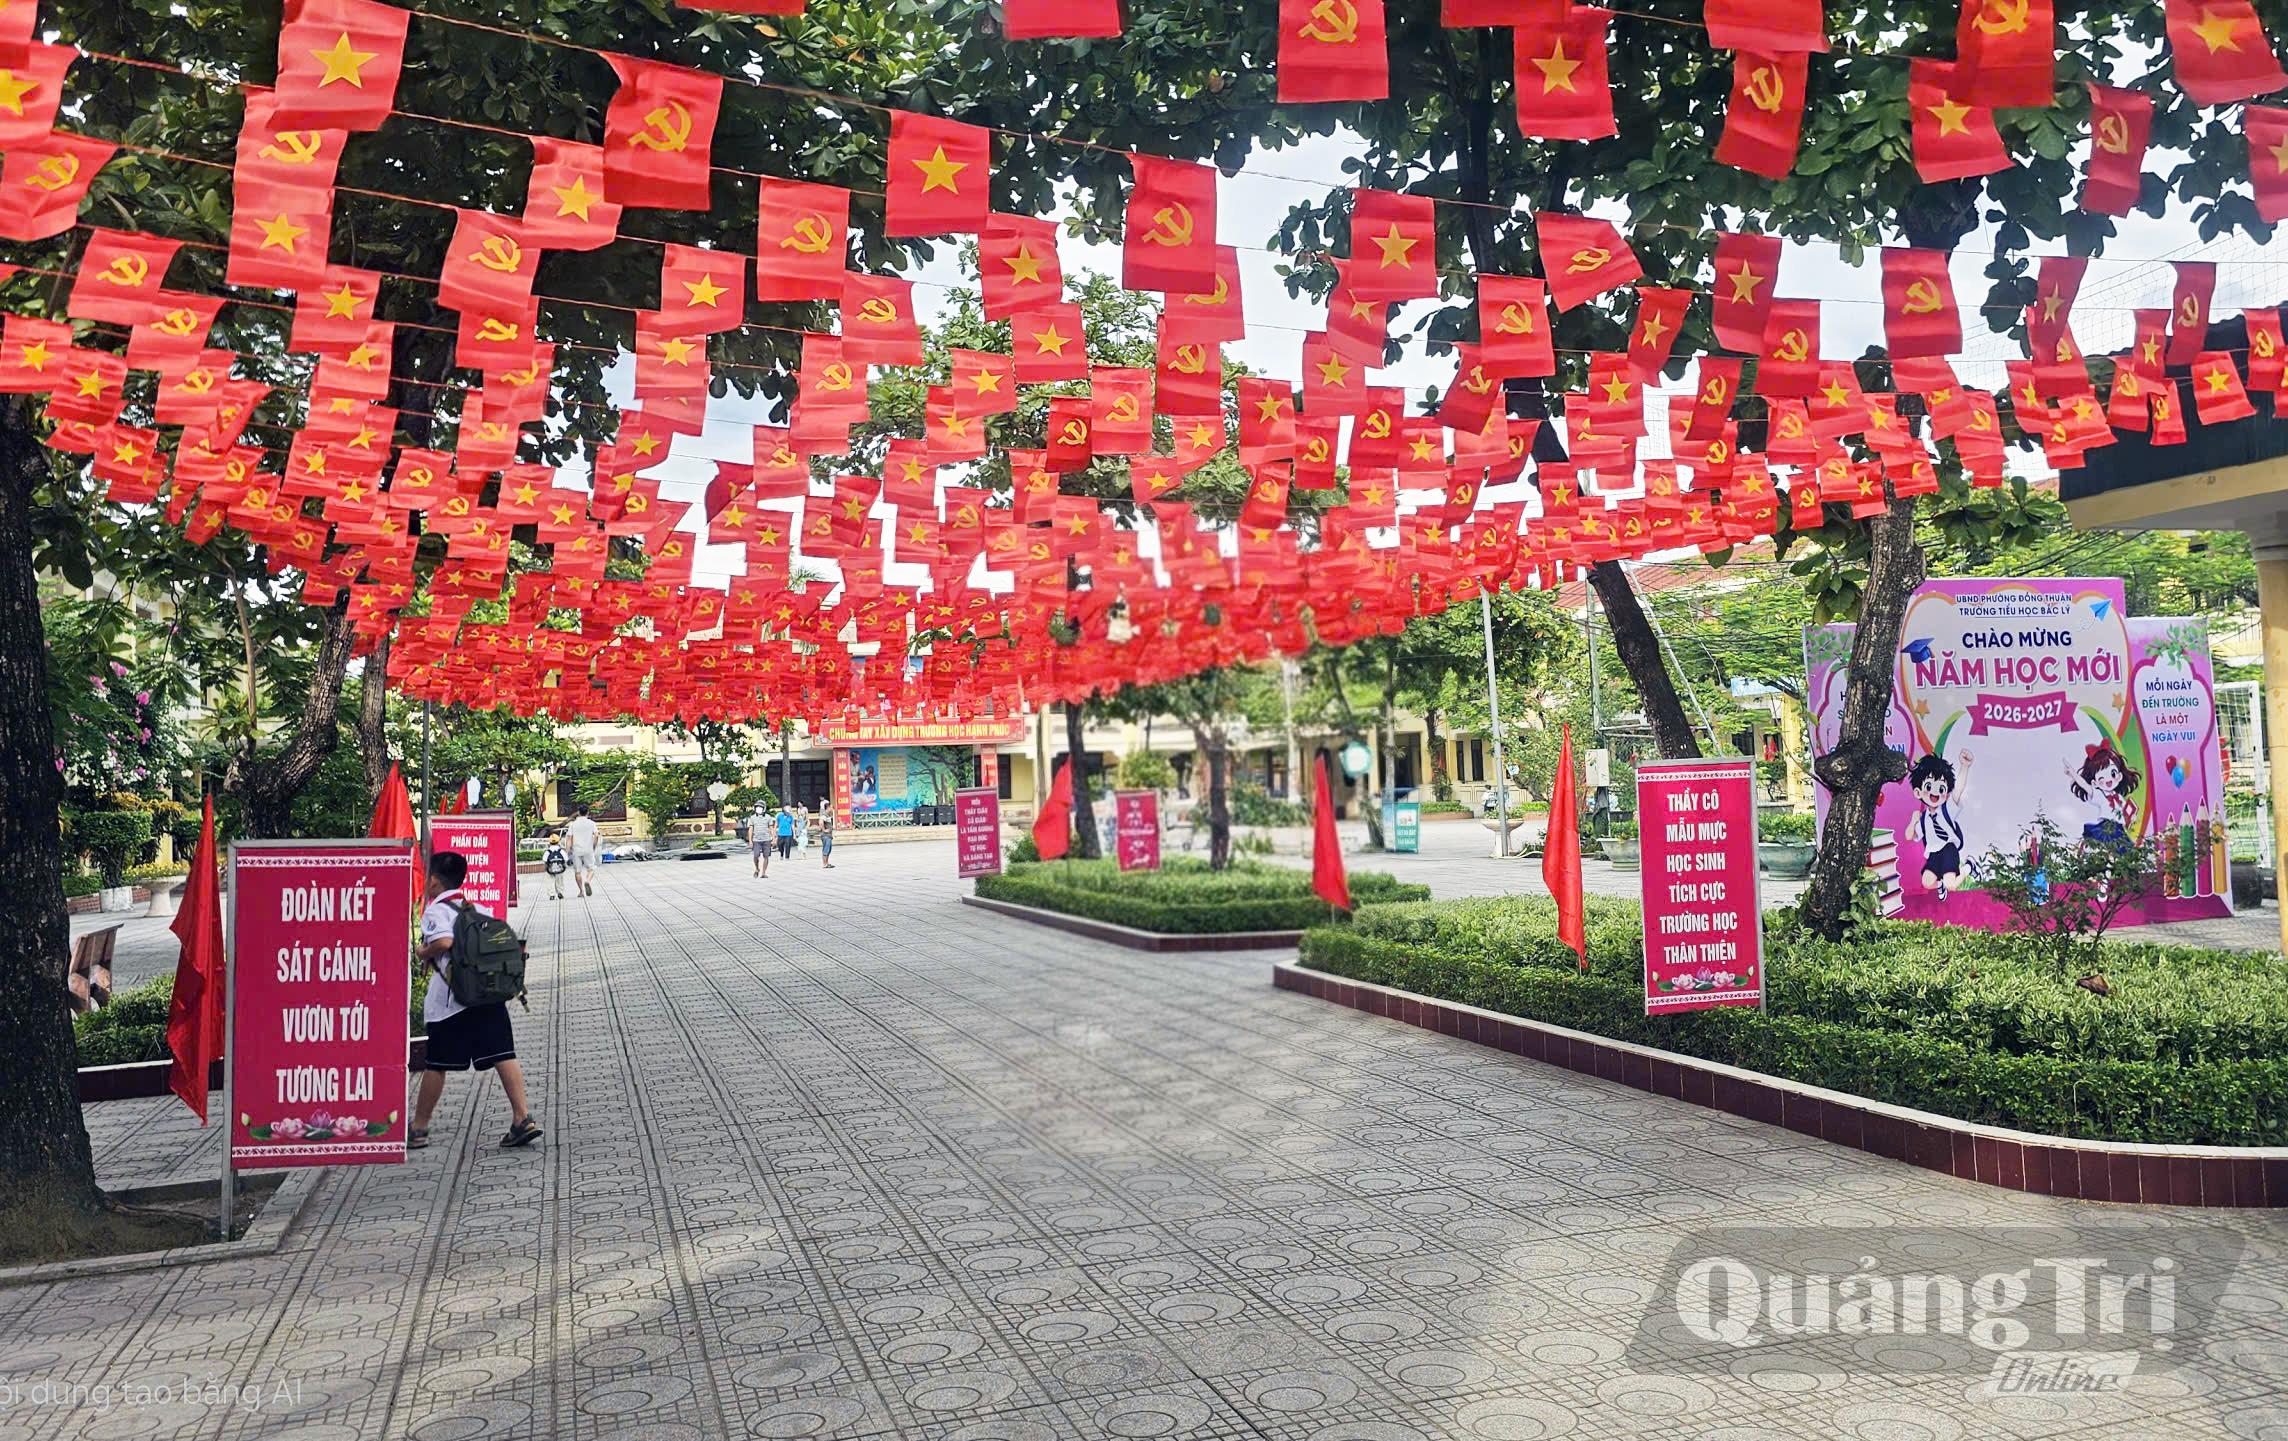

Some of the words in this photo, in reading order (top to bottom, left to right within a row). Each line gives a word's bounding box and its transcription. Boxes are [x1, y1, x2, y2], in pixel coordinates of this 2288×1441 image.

[1956, 595, 1979, 603] UBND
[1959, 605, 1996, 616] TRƯỜNG
[1999, 603, 2016, 615] TIỂU
[2019, 607, 2039, 617] HỌC
[2061, 605, 2071, 615] LÝ
[1962, 627, 2013, 649] CHÀO
[2019, 627, 2072, 647] MỪNG
[1915, 649, 1987, 689] NĂM
[1995, 658, 2058, 692] HỌC
[2066, 652, 2122, 686] MỚI
[2146, 677, 2164, 691] MỖI
[2167, 678, 2192, 691] NGÀY
[1983, 700, 2063, 723] 2026-2027
[2142, 695, 2160, 708] ĐẾN
[2162, 695, 2199, 708] TRƯỜNG
[2156, 713, 2167, 725] LÀ
[2169, 712, 2188, 727] MỘT
[874, 724, 891, 739] XÂY
[948, 725, 965, 740] HỌC
[2152, 730, 2177, 742] NGÀY
[2180, 731, 2196, 741] VUI
[1667, 787, 1699, 812] THẦY
[1702, 789, 1720, 810] CÔ
[451, 832, 471, 848] PHẤN
[473, 832, 488, 847] ĐẤU
[1666, 817, 1695, 843] MẪU
[1698, 820, 1727, 845] MỰC
[1666, 854, 1692, 877] HỌC
[1695, 852, 1726, 872] SINH
[469, 871, 480, 885] TỰ
[480, 872, 495, 886] HỌC
[281, 879, 335, 923] ĐOÀN
[339, 875, 375, 922] KẾT
[461, 888, 479, 901] ĂNG
[480, 887, 500, 901] SỐNG
[1669, 881, 1698, 904] TÍCH
[1700, 882, 1726, 905] CỰC
[1659, 912, 1710, 934] TRƯỜNG
[1712, 911, 1738, 935] HỌC
[276, 939, 314, 983] SÁT
[318, 940, 377, 986] CÁNH,
[1663, 942, 1698, 965] THÂN
[1700, 939, 1737, 965] THIỆN
[282, 1003, 334, 1042] VƯƠN
[340, 999, 369, 1041] TỚI
[276, 1064, 339, 1103] TƯƠNG
[345, 1066, 374, 1101] LAI
